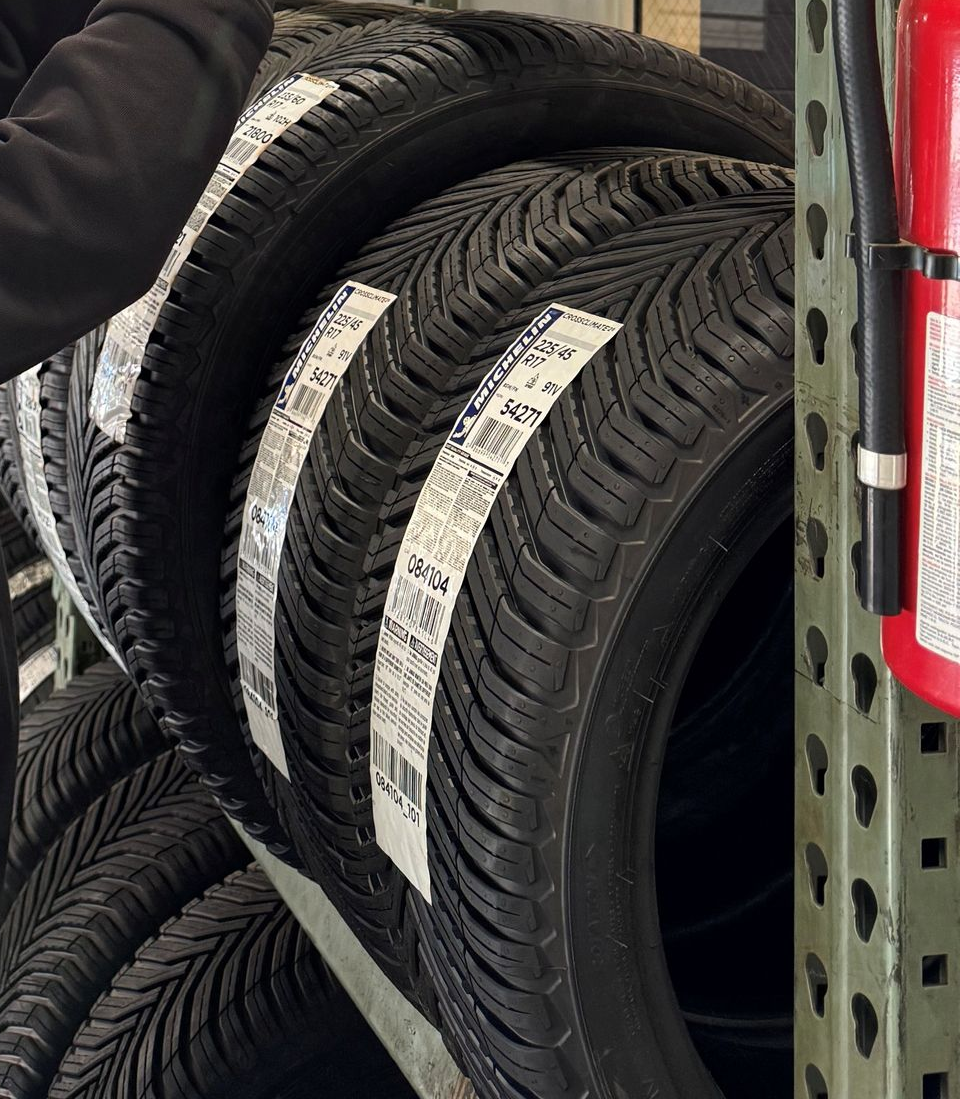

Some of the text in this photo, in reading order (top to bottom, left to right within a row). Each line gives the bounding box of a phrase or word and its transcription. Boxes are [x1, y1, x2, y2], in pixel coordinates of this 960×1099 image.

[242, 125, 274, 144] 21800
[324, 326, 343, 340] R17
[332, 313, 363, 332] 225/45
[291, 289, 348, 380] MICHELIN
[337, 348, 353, 362] 91V
[520, 353, 547, 369] R17
[532, 339, 578, 361] 225/45
[473, 312, 554, 411] MICHELIN
[309, 366, 339, 390] 54271
[541, 381, 563, 396] 91V
[499, 398, 543, 428] 54271
[407, 552, 451, 597] 084104
[375, 771, 420, 828] 084104_101
